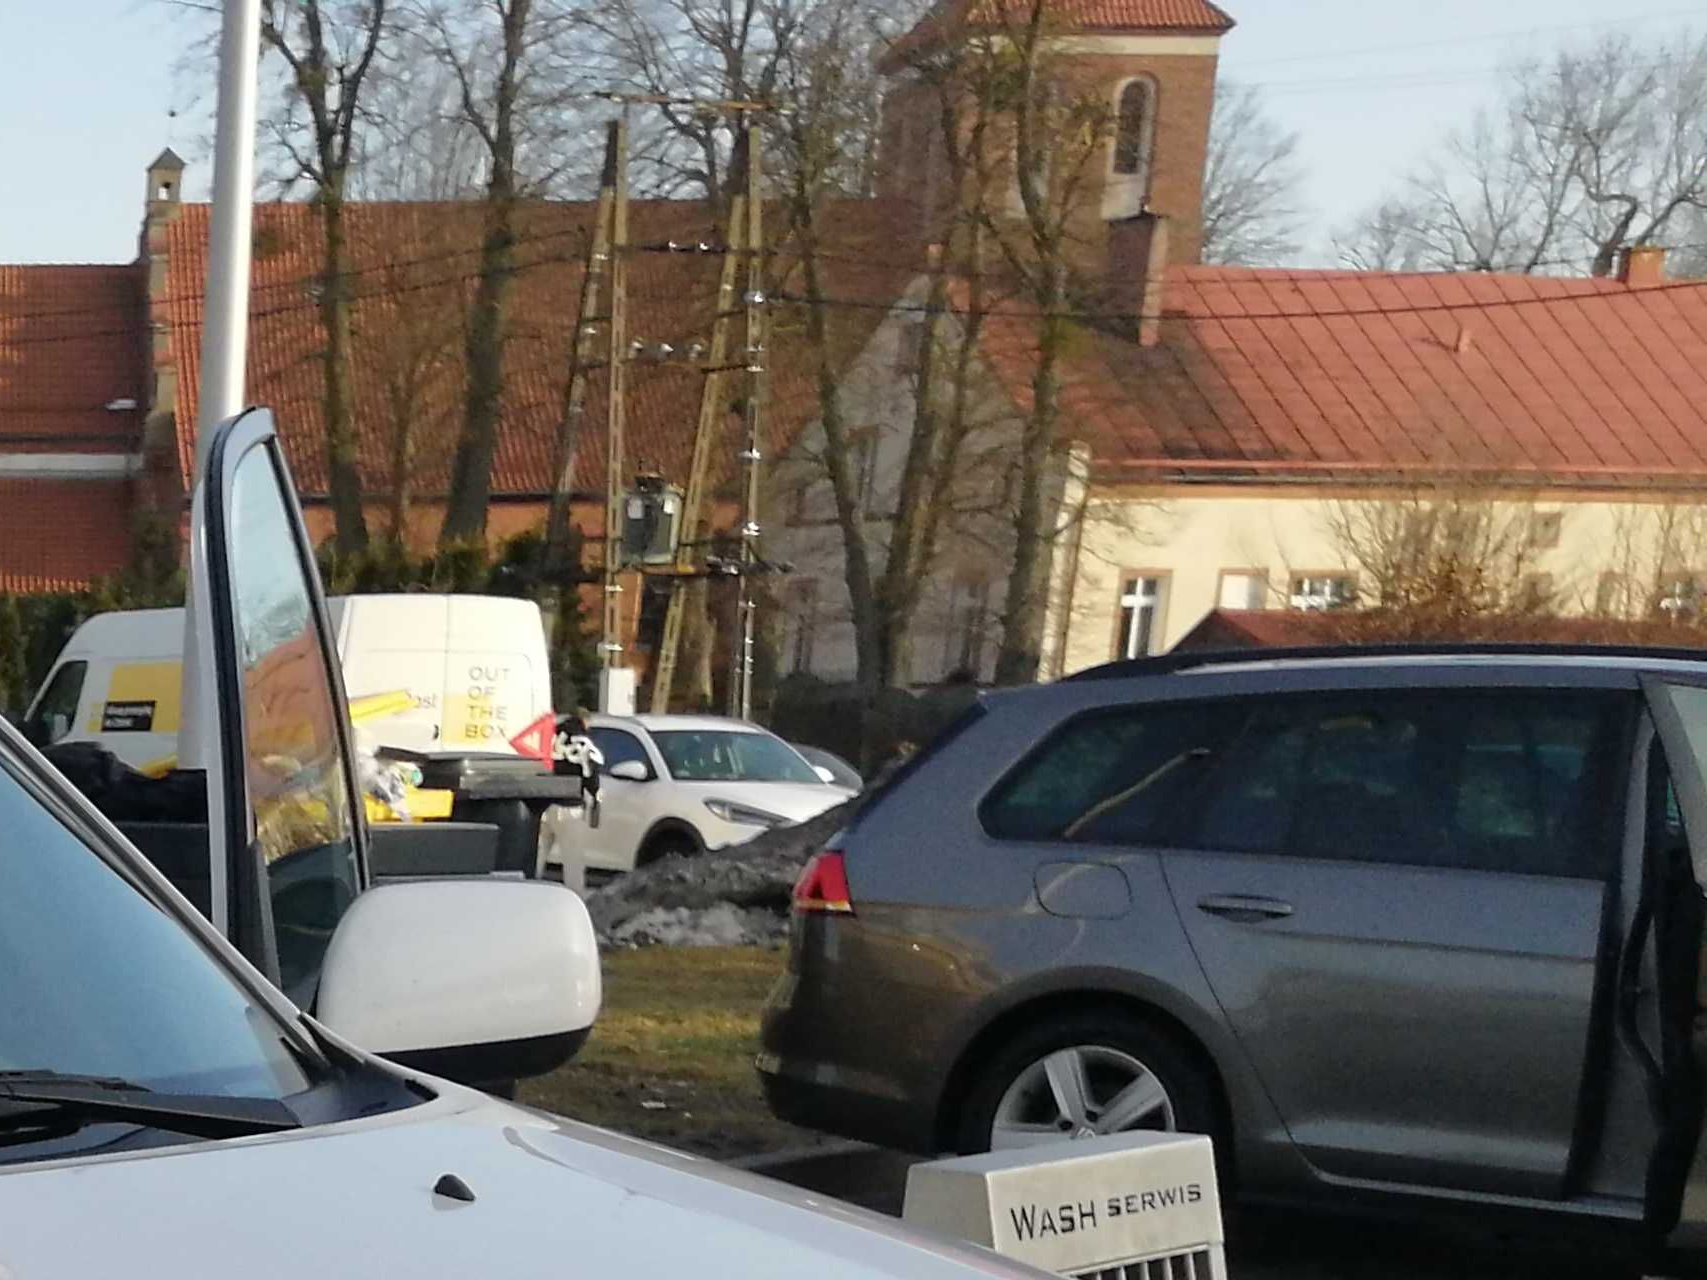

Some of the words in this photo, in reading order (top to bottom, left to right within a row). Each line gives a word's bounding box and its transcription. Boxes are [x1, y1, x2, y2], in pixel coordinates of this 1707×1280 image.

[468, 666, 510, 681] OUT
[467, 686, 495, 700] OF
[467, 705, 508, 720] THE
[1010, 1200, 1097, 1241] WASH
[1107, 1184, 1202, 1217] SERWIS
